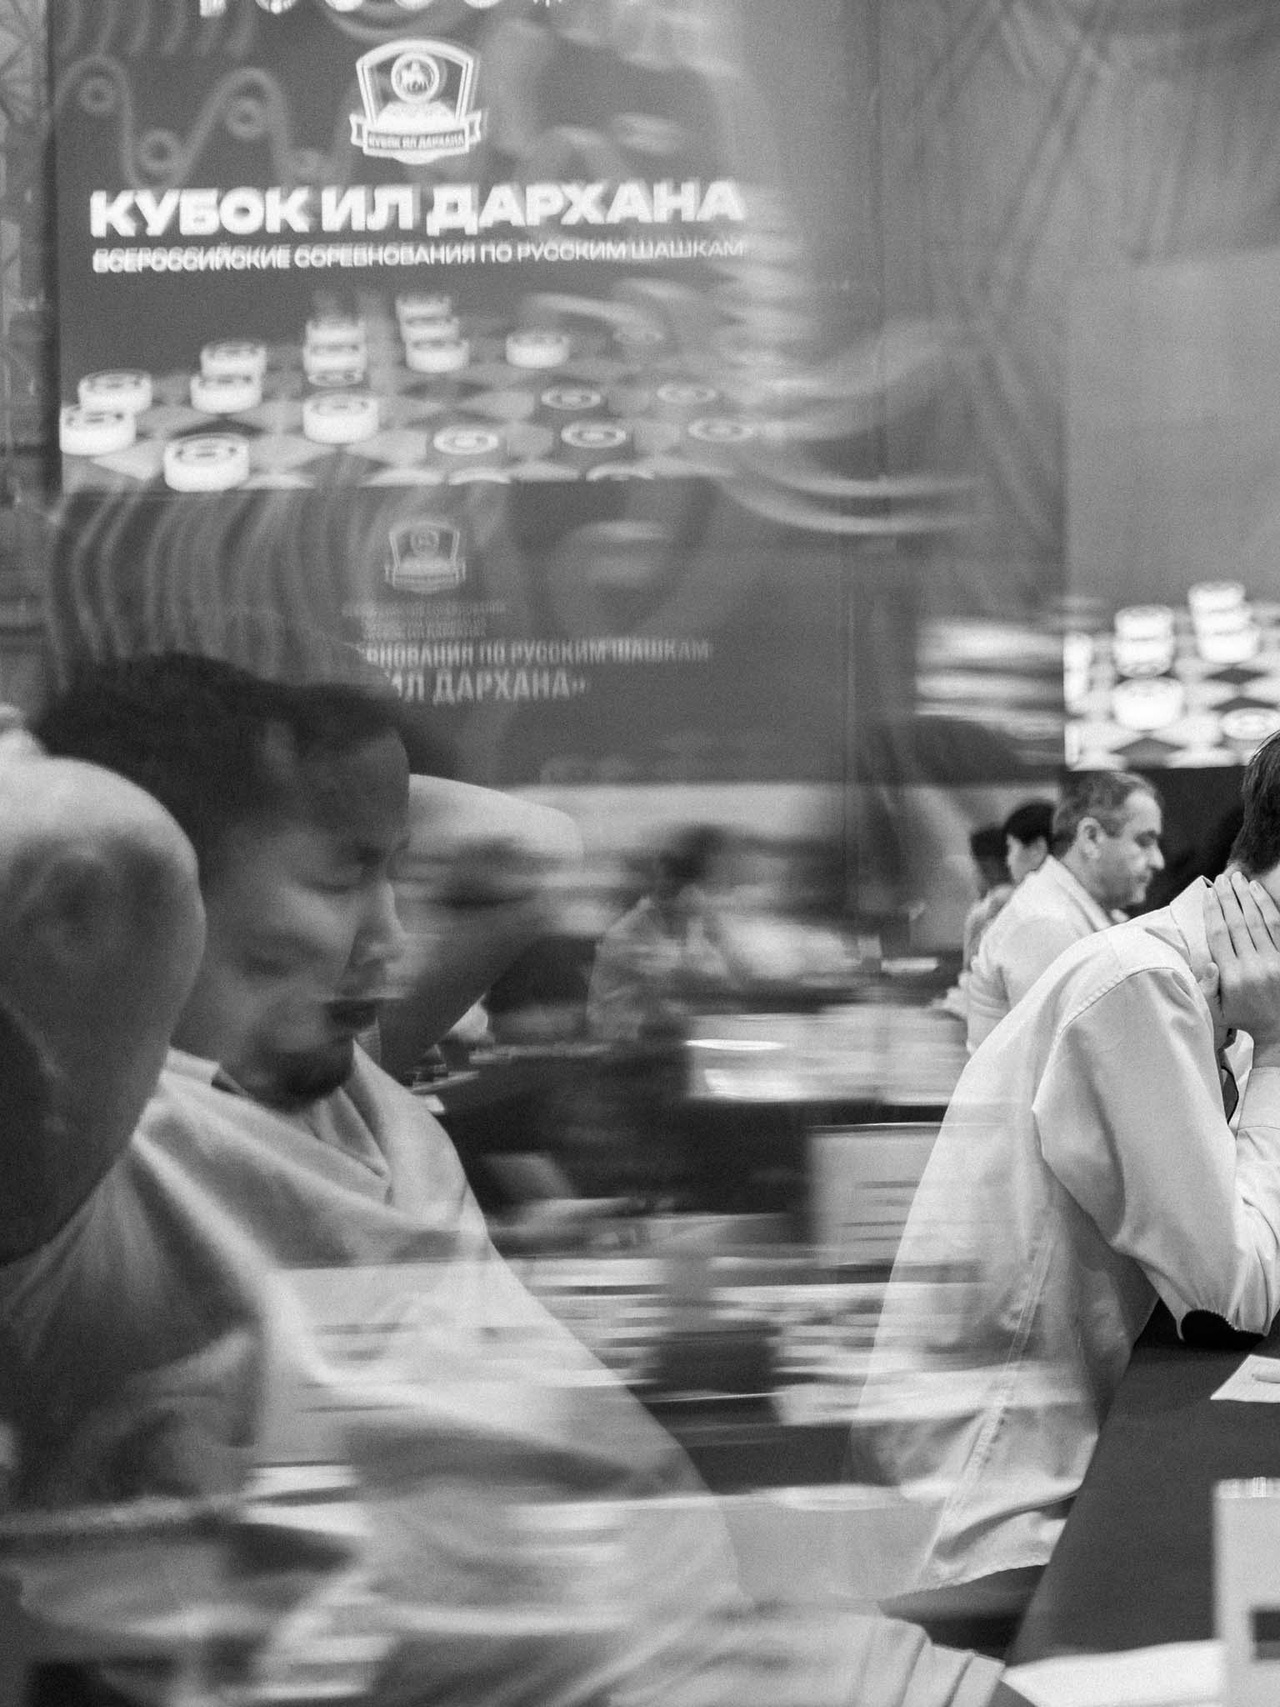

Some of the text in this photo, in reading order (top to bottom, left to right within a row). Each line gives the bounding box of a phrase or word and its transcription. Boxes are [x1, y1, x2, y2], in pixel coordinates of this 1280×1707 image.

[90, 180, 745, 237] КУБОК ИЛ ДАРХАНА
[92, 238, 745, 273] ВСЕРОССИЙСКИЕ СОРЕВНОВАНИЯ ПО РУССКИМ ШАШКАМ
[511, 638, 607, 665] РУССКИМ
